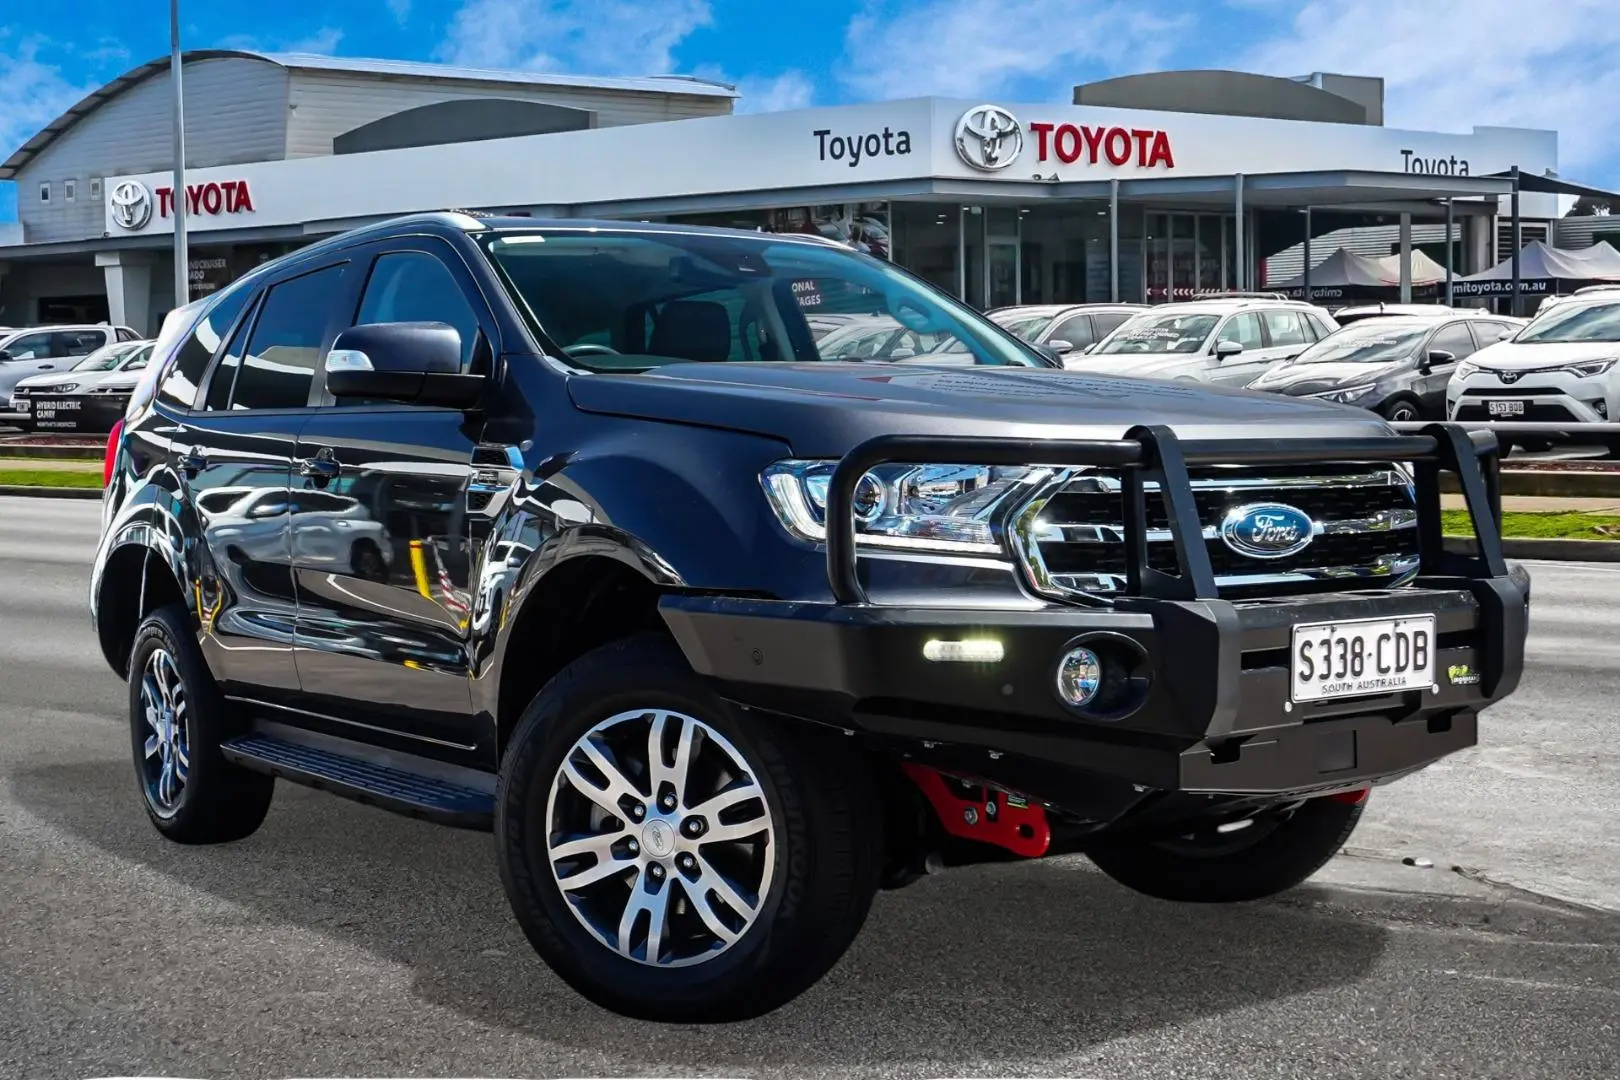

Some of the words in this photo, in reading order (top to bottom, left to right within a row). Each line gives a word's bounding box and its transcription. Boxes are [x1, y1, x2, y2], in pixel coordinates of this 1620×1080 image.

[813, 126, 912, 167] Toyota
[1030, 122, 1174, 168] TOYOTA
[791, 280, 815, 292] ONAL
[1453, 282, 1547, 295] mitoyota.cm.au
[797, 294, 821, 306] AGES
[1251, 514, 1298, 542] Ford
[1321, 683, 1353, 695] SOUTH
[1357, 676, 1407, 690] AUSTRALIA
